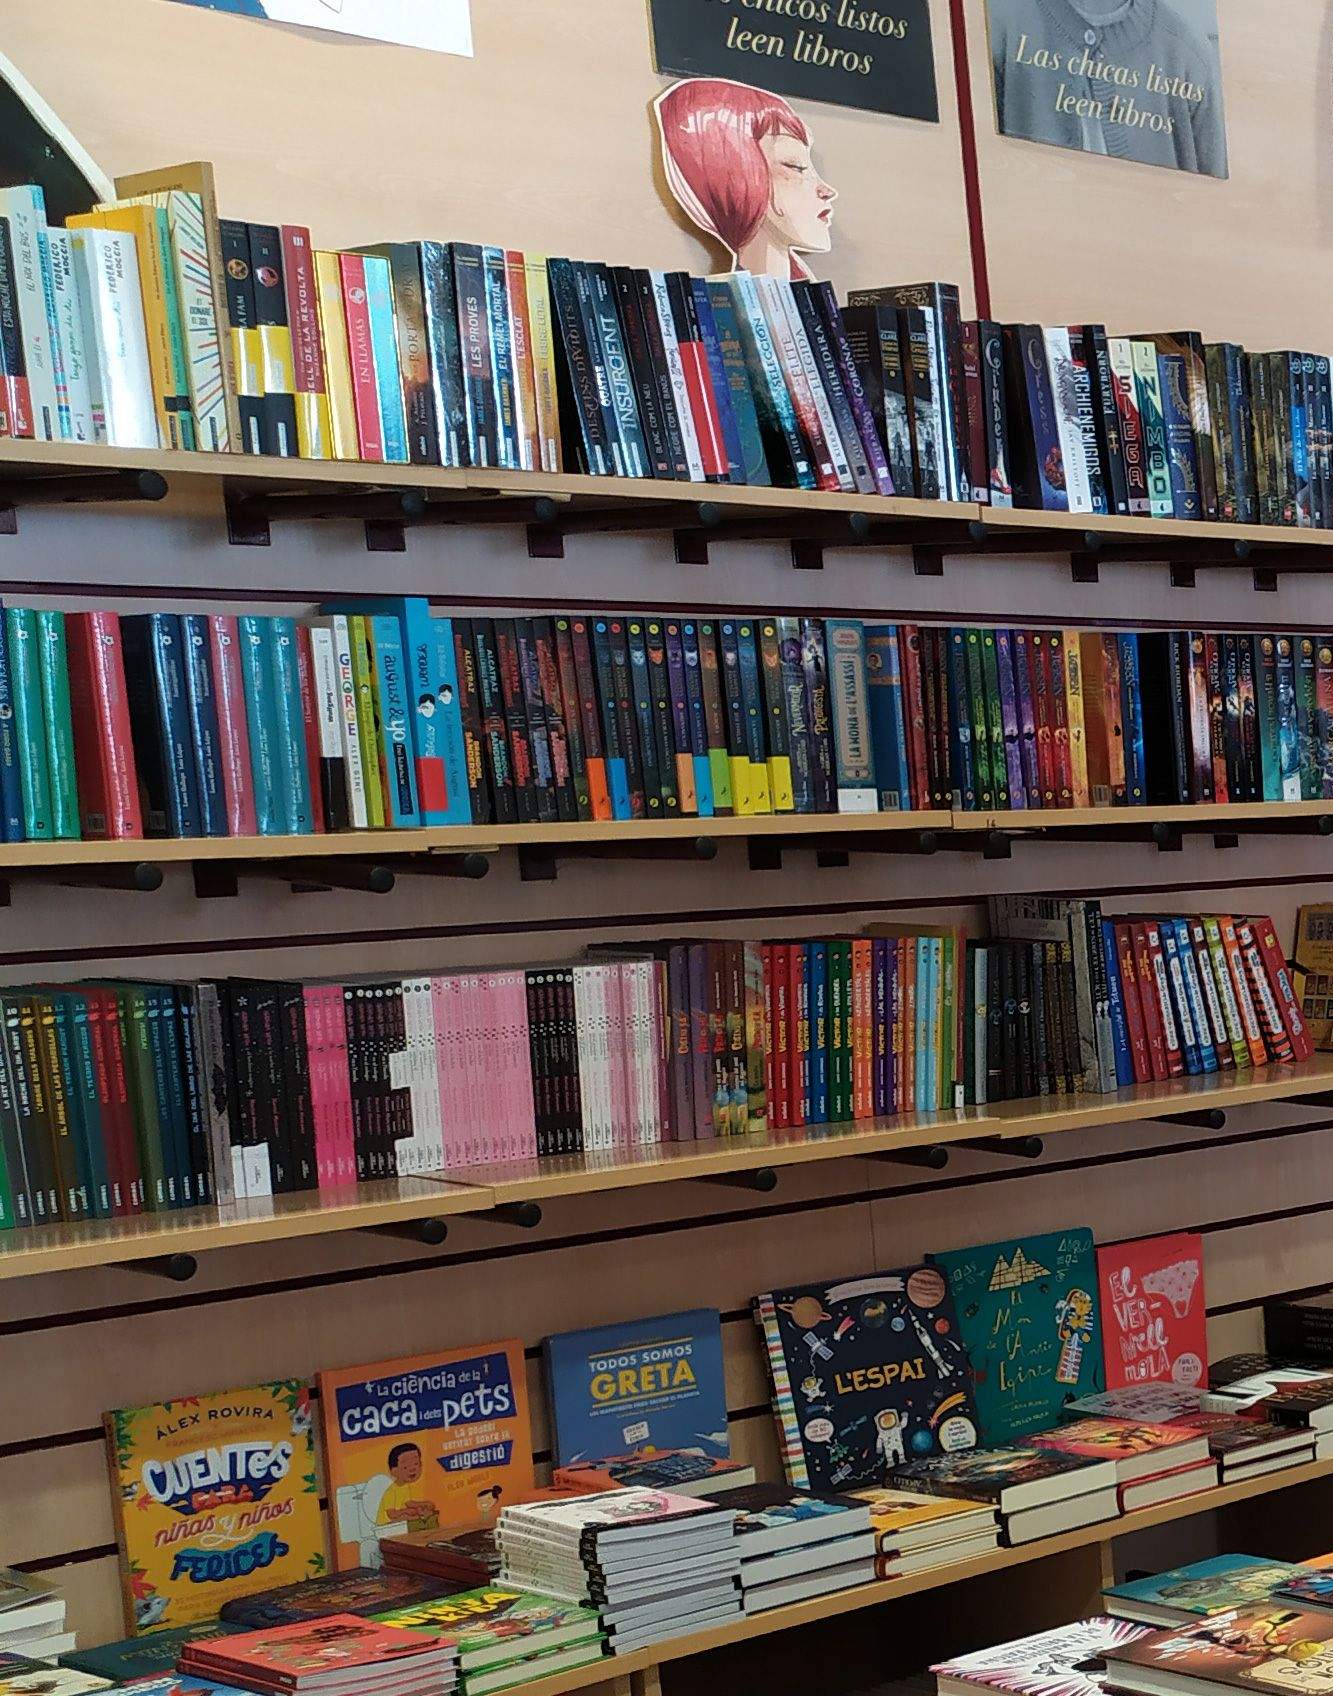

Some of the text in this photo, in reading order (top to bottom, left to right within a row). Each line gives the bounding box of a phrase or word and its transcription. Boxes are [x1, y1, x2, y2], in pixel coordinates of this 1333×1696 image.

[837, 0, 908, 38] listos
[726, 17, 874, 75] leen libros
[1016, 34, 1205, 102] Las chicas listas
[1056, 84, 1175, 134] leen libros
[466, 296, 478, 344] PROVES
[601, 317, 638, 431] INSURGENT
[340, 654, 356, 735] GEORGE
[589, 1344, 693, 1372] TODOS SOMOS
[590, 1358, 696, 1400] GRETA
[834, 1356, 927, 1397] L'ESPAI
[391, 1371, 456, 1396] ciència
[458, 1373, 470, 1383] de
[472, 1370, 481, 1381] la
[156, 1406, 274, 1440] ÁLEX ROVIRA
[342, 1399, 418, 1436] caca
[424, 1407, 442, 1420] dels
[443, 1383, 510, 1431] pets
[450, 1444, 505, 1470] digestió
[154, 1512, 216, 1548] niñas
[238, 1497, 294, 1529] niños
[170, 1531, 289, 1584] FELICES
